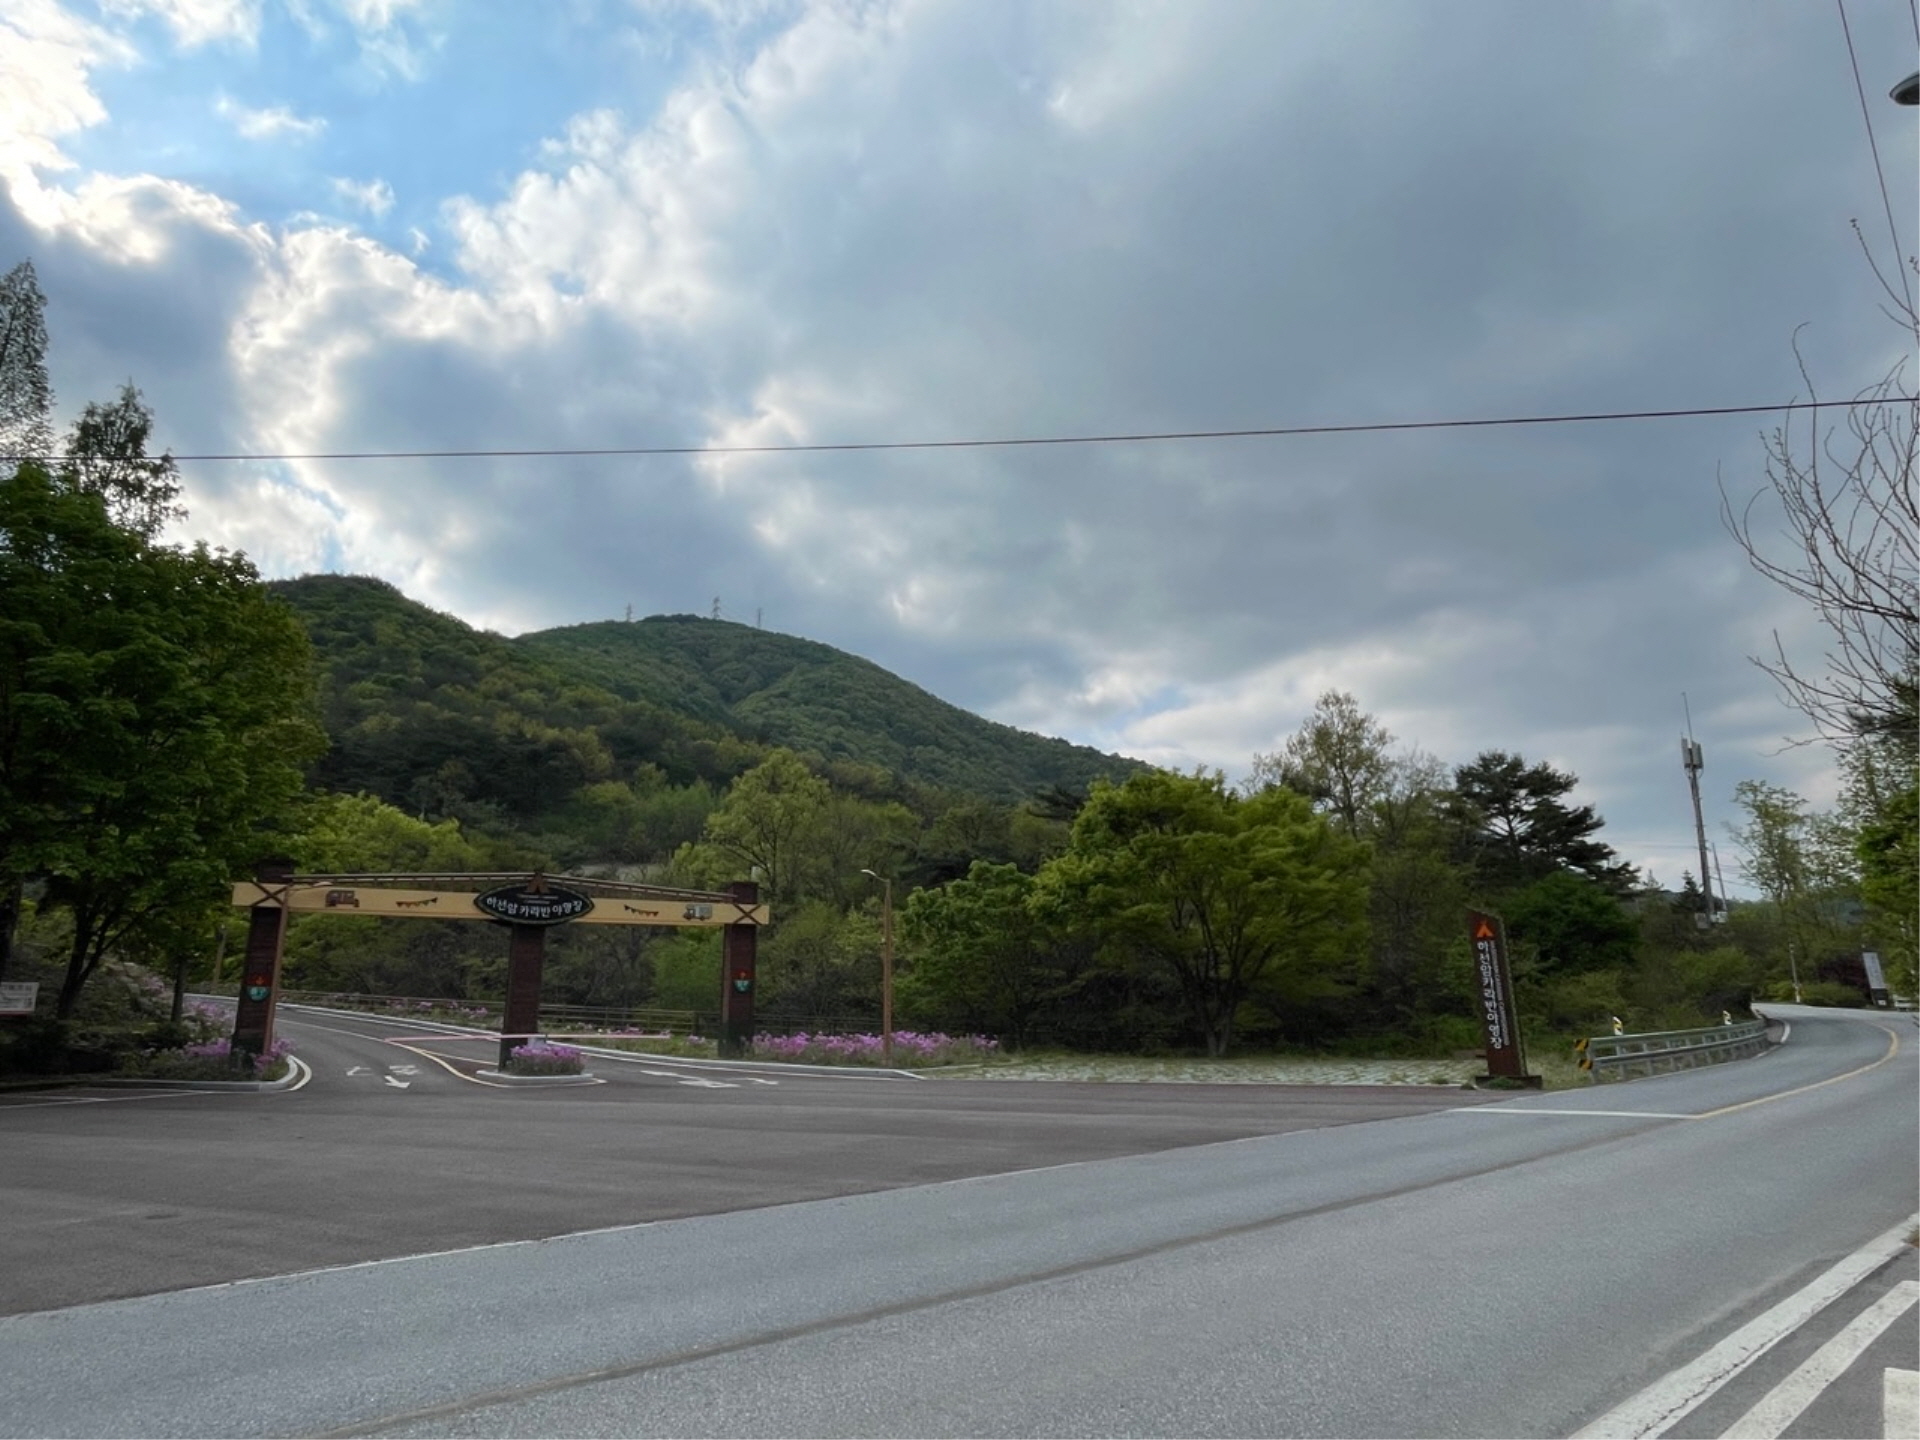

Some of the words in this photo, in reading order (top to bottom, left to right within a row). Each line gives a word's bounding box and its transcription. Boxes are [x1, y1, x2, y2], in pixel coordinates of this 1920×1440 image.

[486, 897, 518, 914] 하선암
[519, 905, 551, 918] 카라반
[552, 900, 583, 916] 야영장
